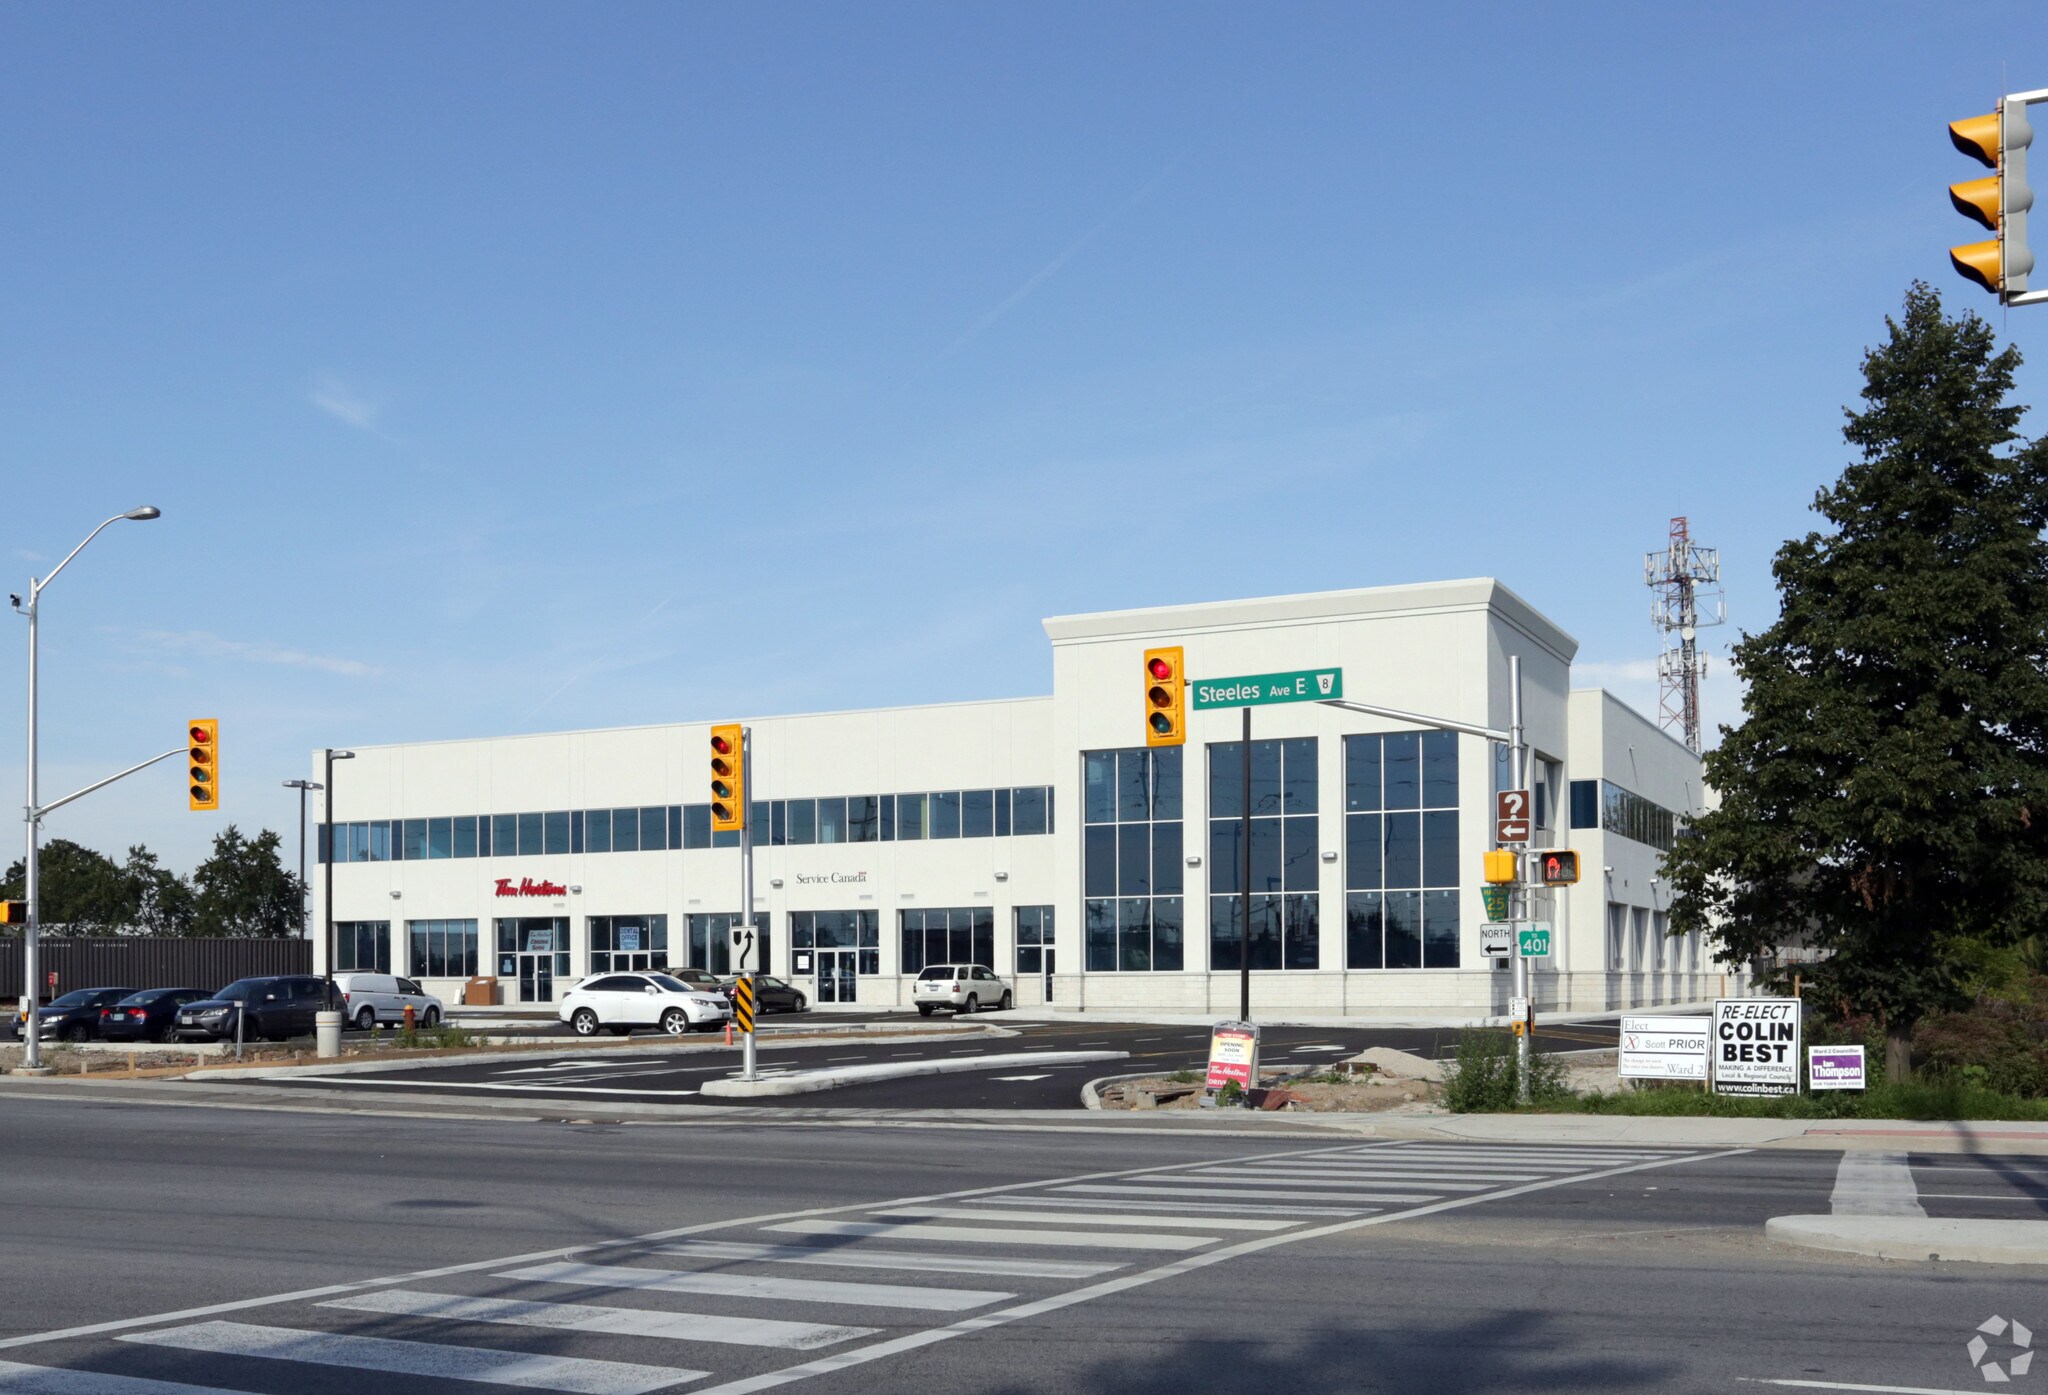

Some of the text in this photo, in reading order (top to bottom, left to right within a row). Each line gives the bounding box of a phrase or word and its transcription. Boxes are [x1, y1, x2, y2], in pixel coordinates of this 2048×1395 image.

[1322, 678, 1329, 689] 8
[1199, 678, 1306, 702] Steeles Ave E
[796, 872, 866, 884] Service Canada
[495, 877, 567, 897] Tim Hortons
[1487, 897, 1505, 910] 25
[1482, 930, 1510, 938] NORTH
[1523, 938, 1547, 952] 401
[1722, 1005, 1791, 1019] RE-ELECT
[1624, 1020, 1648, 1030] Elect
[1719, 1022, 1794, 1041] COLIN
[1645, 1039, 1705, 1050] Scott PRIOR
[1723, 1043, 1788, 1063] BEST
[1210, 1066, 1247, 1077] Tim Hortons
[1667, 1063, 1704, 1075] Ward 2
[1813, 1065, 1860, 1080] Thompson
[1718, 1083, 1795, 1094] www.colinbest.ca
